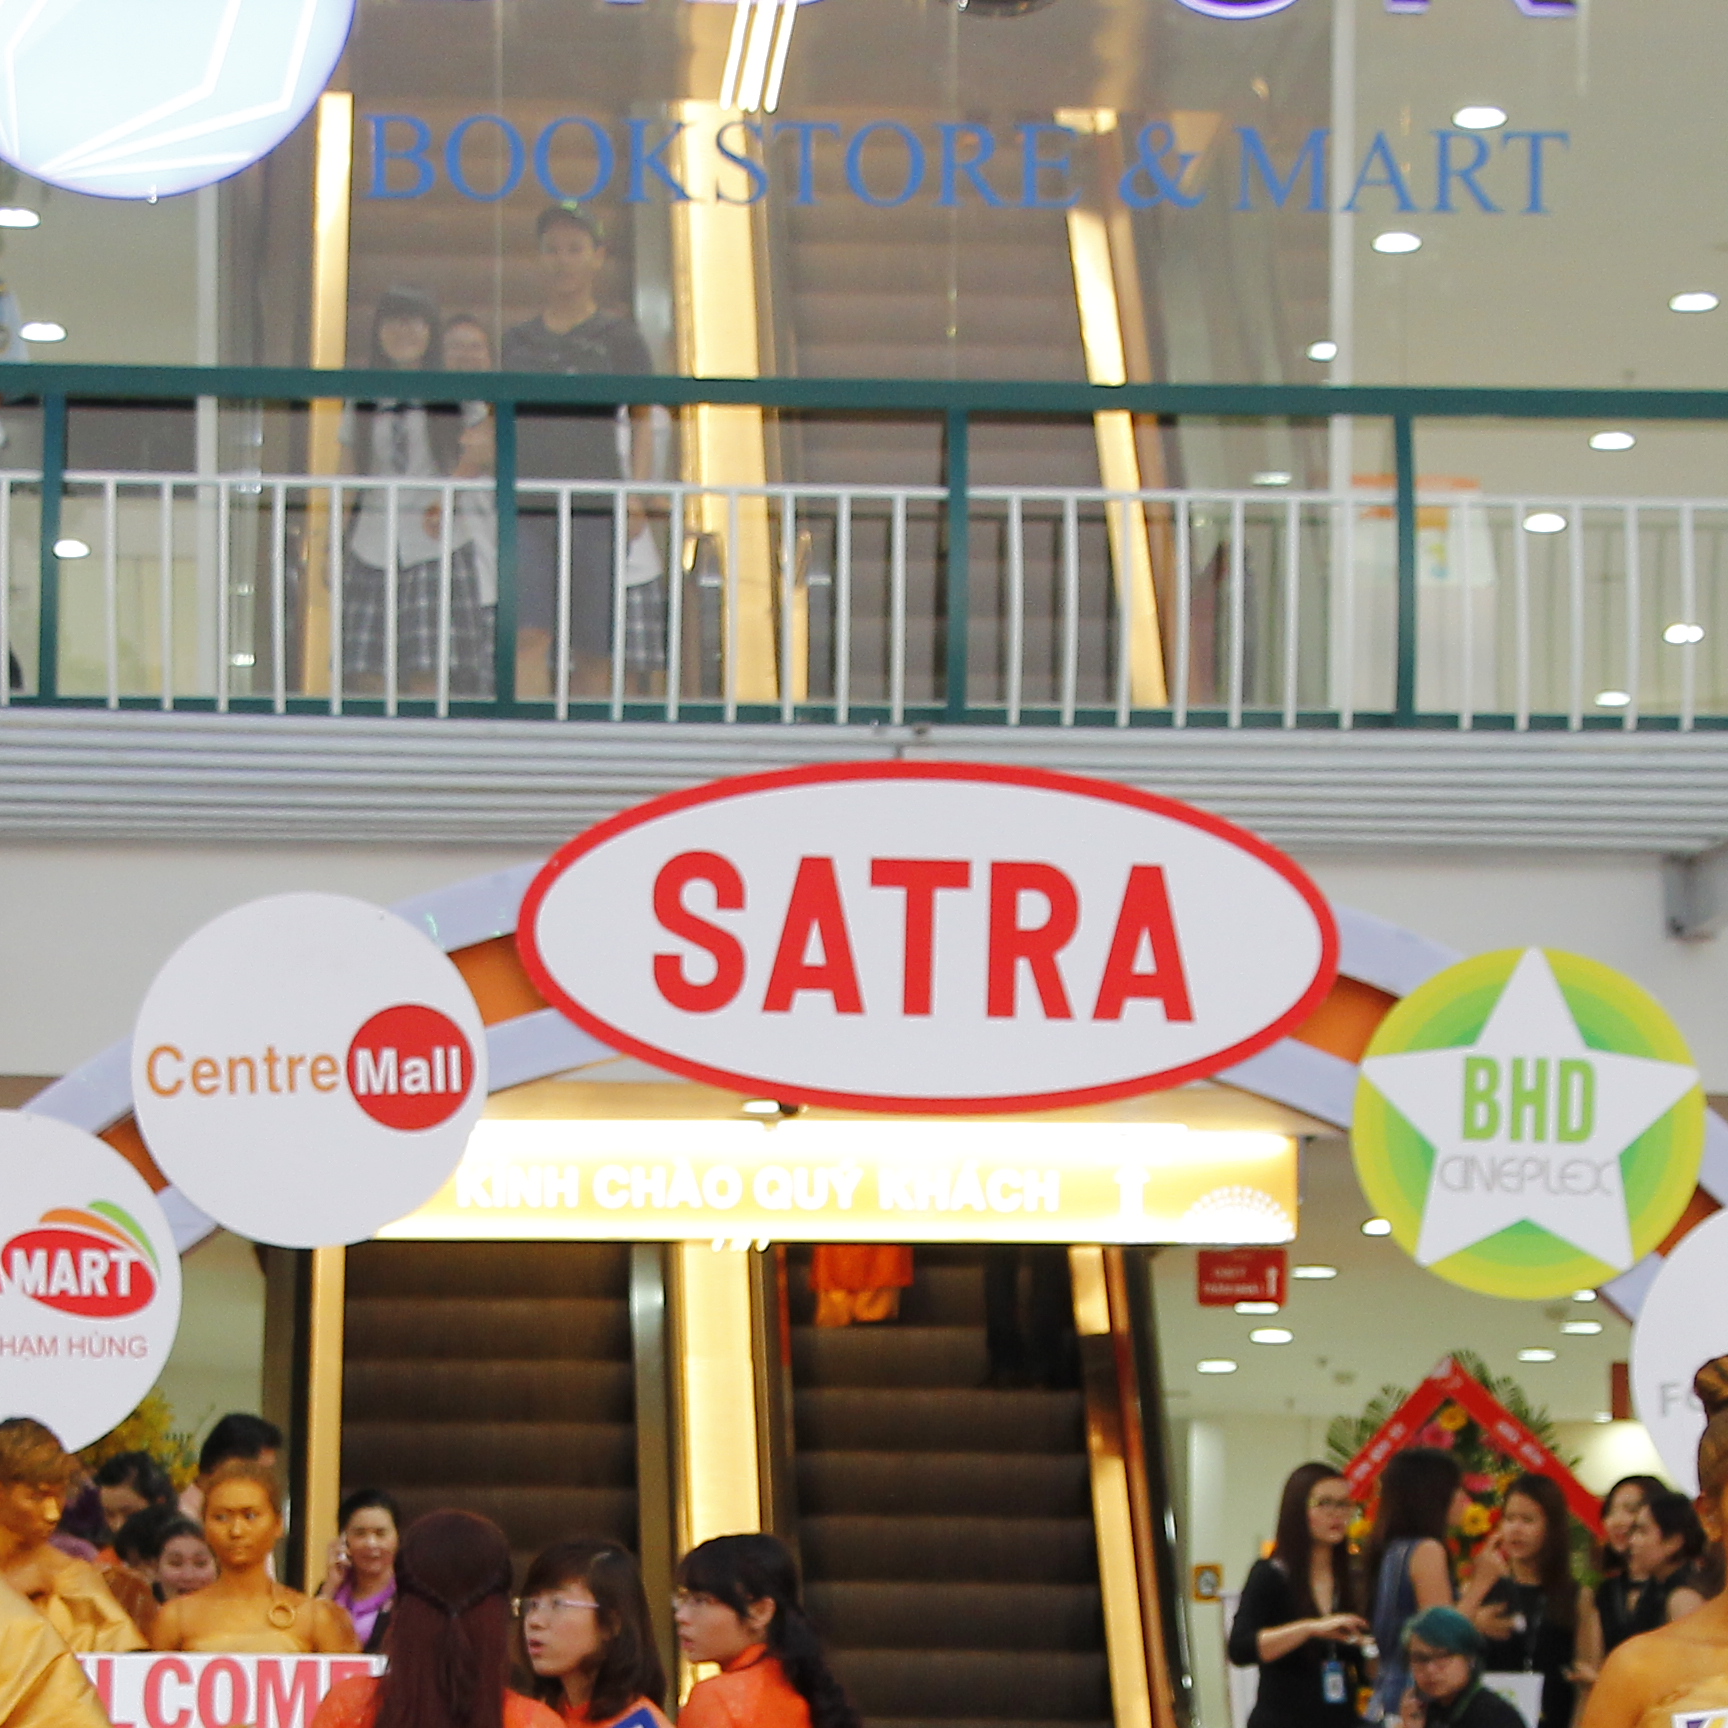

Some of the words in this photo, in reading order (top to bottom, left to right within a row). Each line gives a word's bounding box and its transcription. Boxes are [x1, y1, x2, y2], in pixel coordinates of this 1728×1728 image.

[366, 114, 1084, 212] BOOKSTORE
[1119, 120, 1206, 211] &
[1232, 124, 1571, 216] MART
[652, 850, 1195, 1022] SATRA
[1462, 1056, 1597, 1143] BHD
[1440, 1155, 1615, 1197] CINEPLEX
